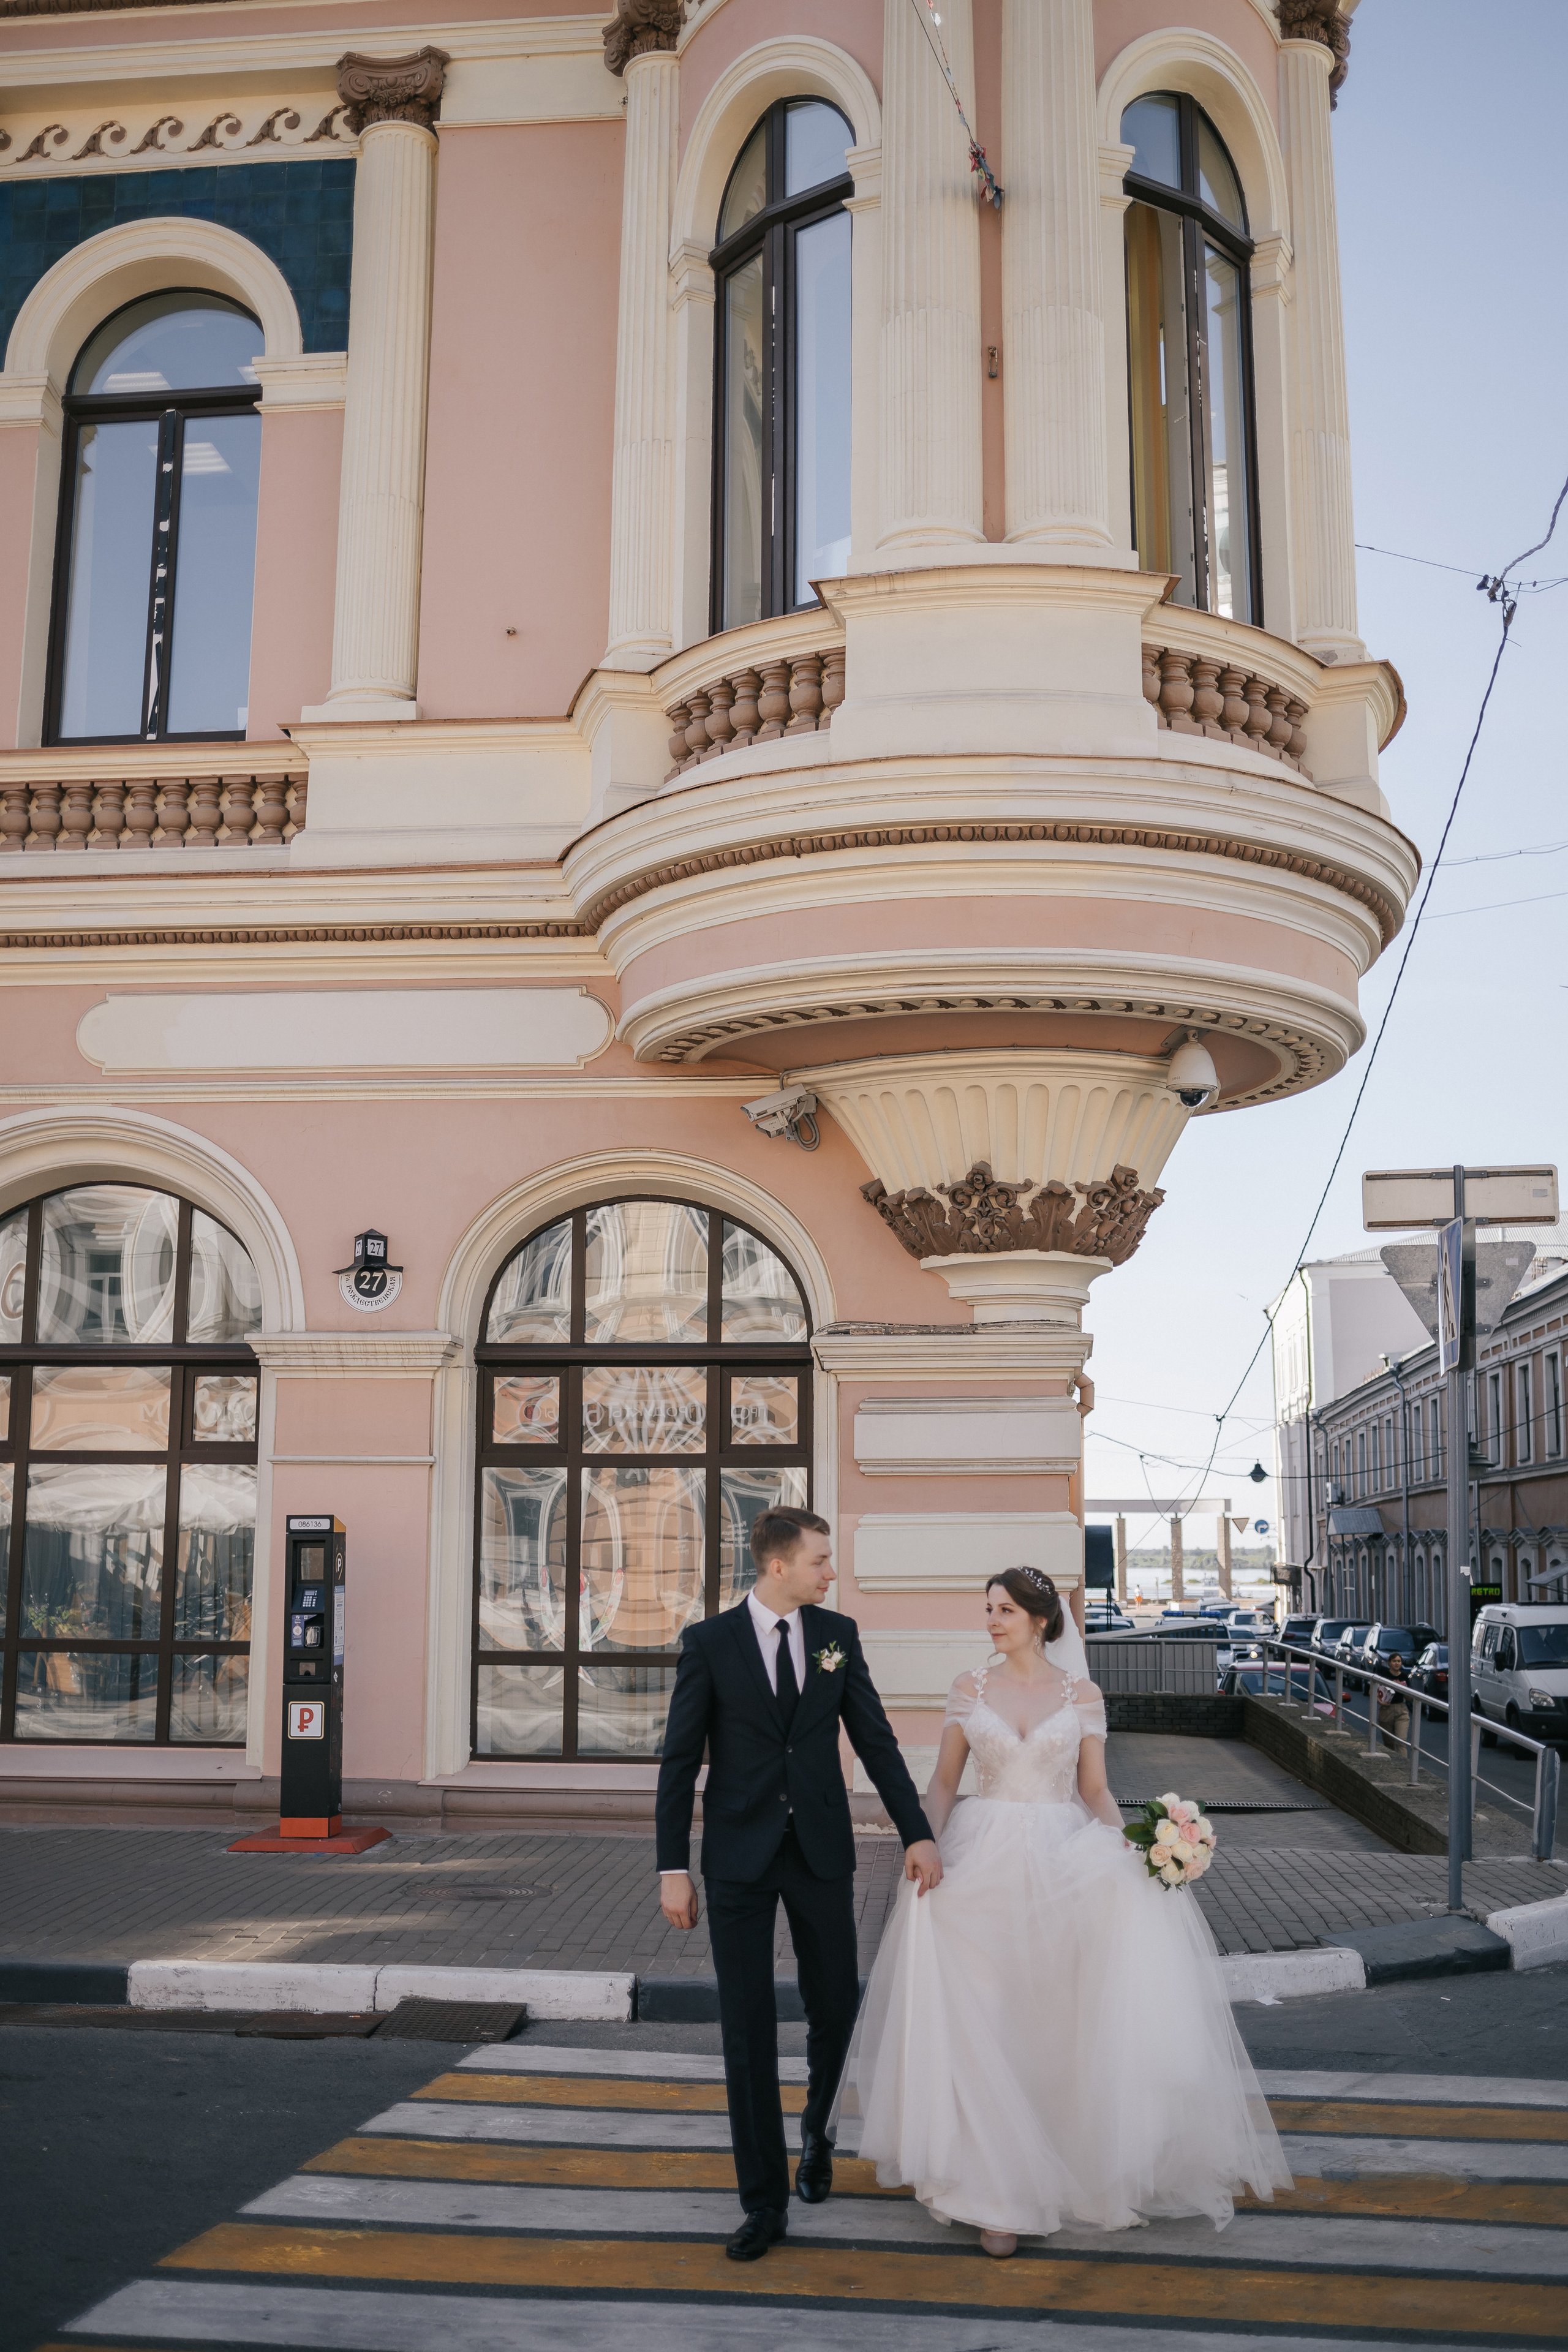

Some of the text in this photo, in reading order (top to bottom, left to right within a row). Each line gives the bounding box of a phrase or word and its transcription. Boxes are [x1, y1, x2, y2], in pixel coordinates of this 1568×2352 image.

[370, 1242, 381, 1255] 27
[346, 1276, 396, 1306] РОЖДЕСТВЕНСКАЯ
[359, 1271, 383, 1291] 27
